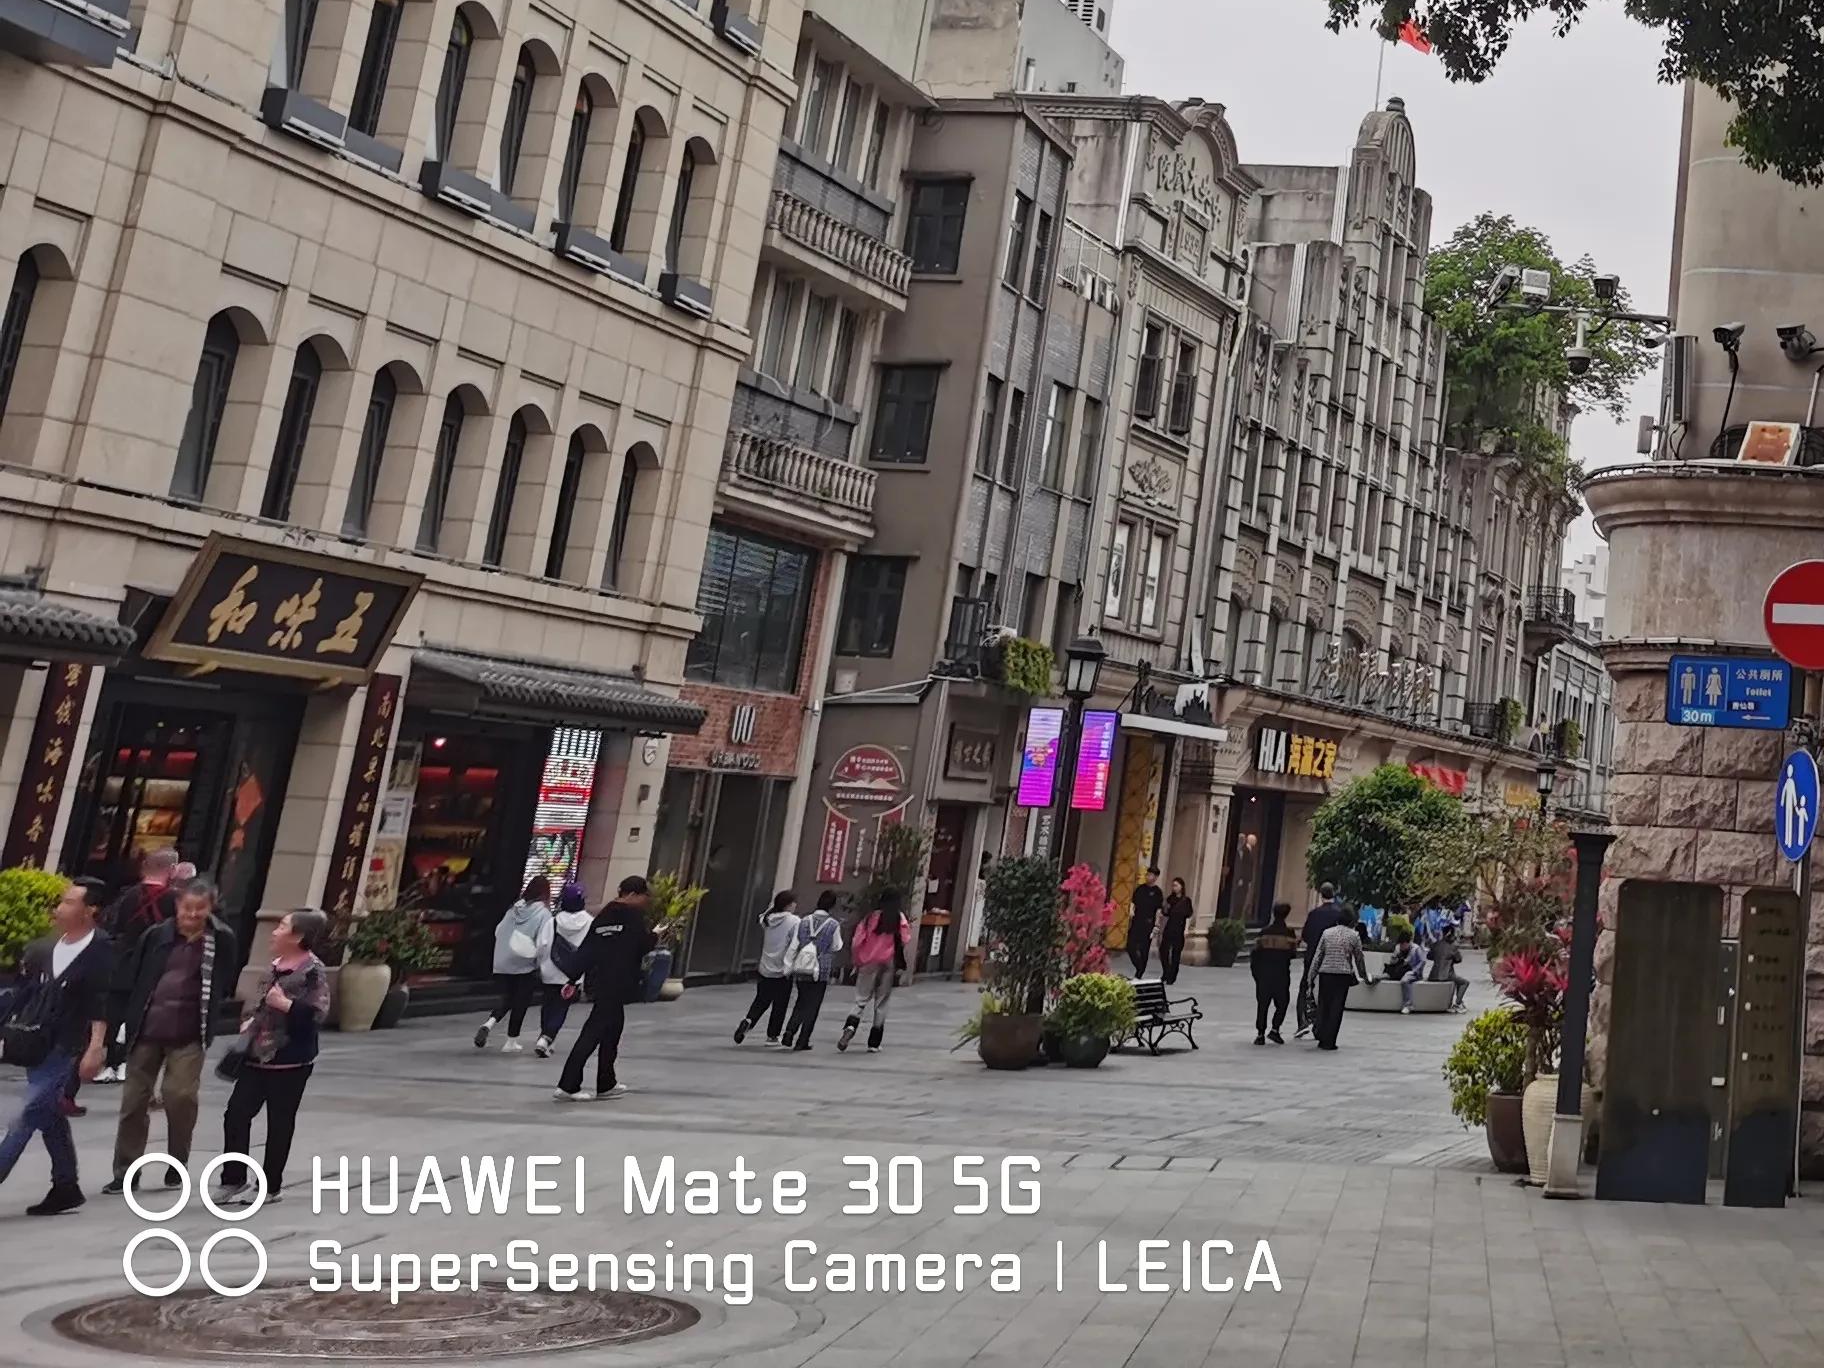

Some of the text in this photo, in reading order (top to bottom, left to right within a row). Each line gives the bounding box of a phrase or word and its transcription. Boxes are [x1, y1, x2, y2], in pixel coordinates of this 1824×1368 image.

[1735, 668, 1783, 681] 公共厕所
[1258, 728, 1338, 779] HLA 海澜之家
